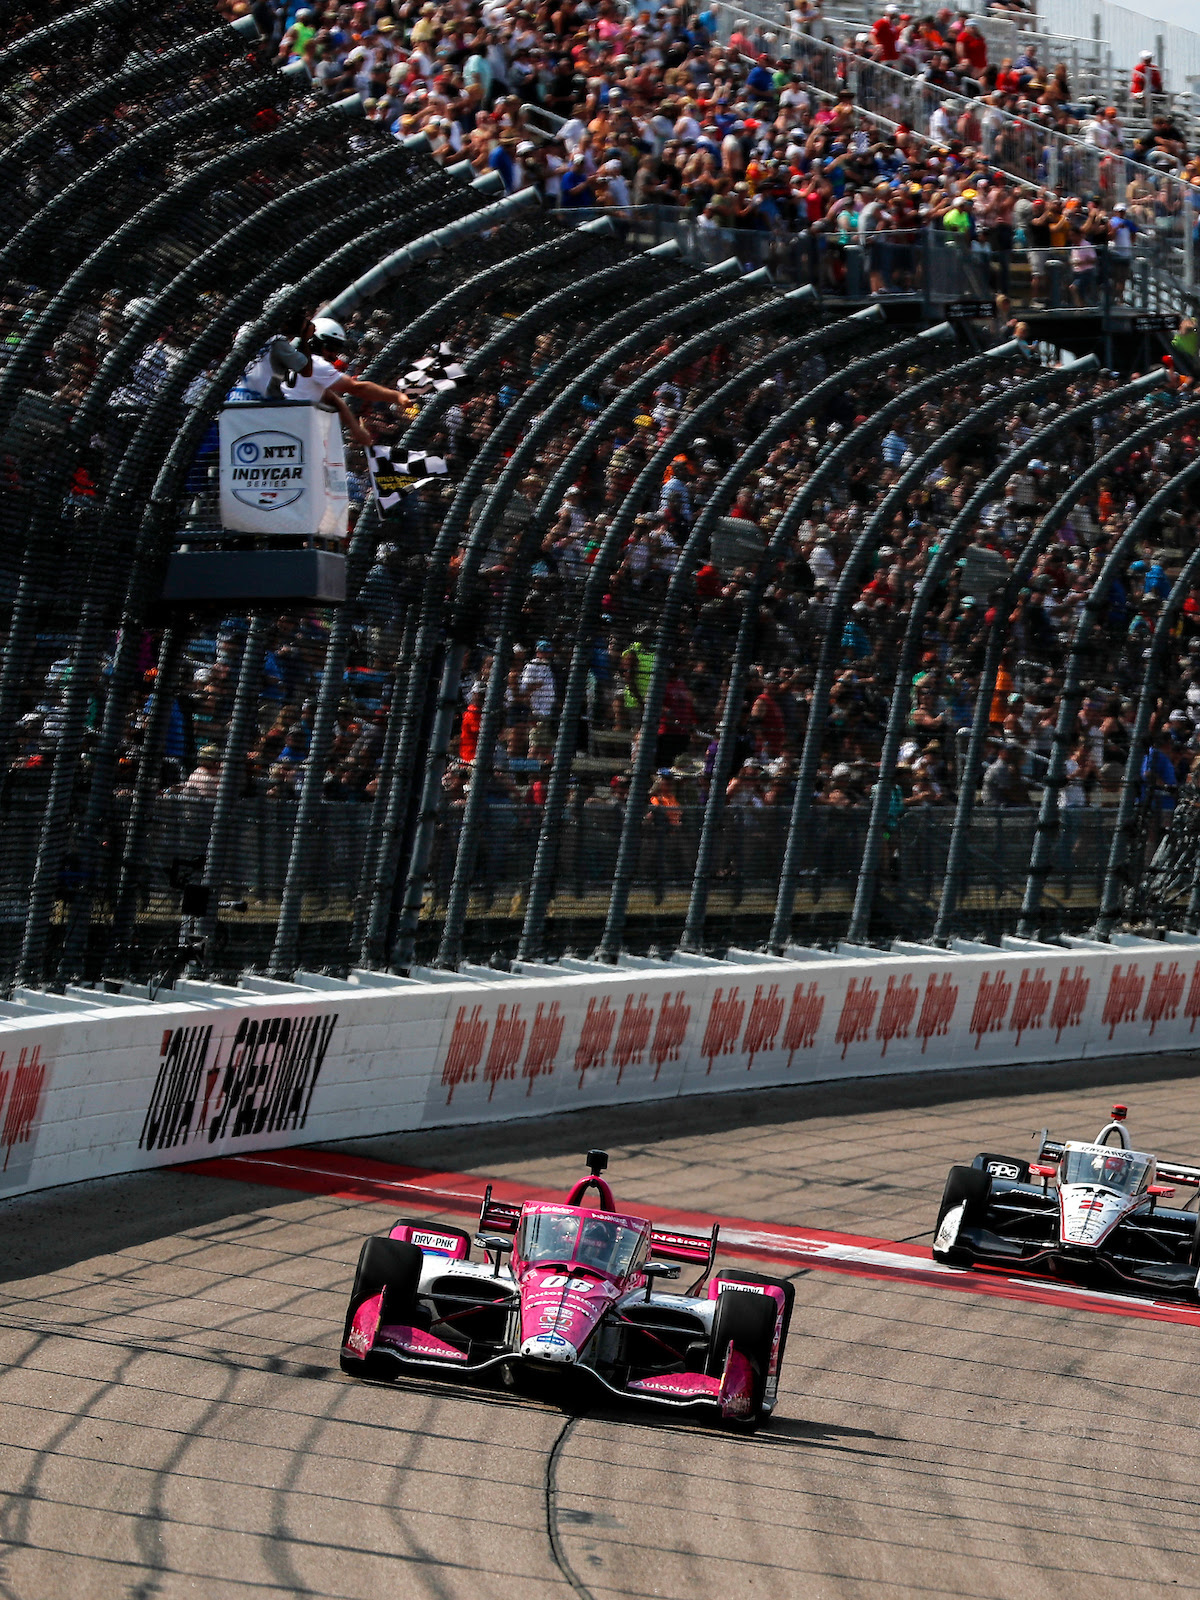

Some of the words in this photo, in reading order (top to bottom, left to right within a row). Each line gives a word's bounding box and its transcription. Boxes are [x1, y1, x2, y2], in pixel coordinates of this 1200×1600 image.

[263, 445, 296, 459] NTT
[232, 468, 303, 481] INDYCAR
[247, 480, 288, 488] SERIES
[208, 1014, 339, 1143] SPEEDWAY
[989, 1165, 1017, 1178] PPG
[1079, 1200, 1104, 1212] 2
[540, 1275, 595, 1293] 06
[385, 1338, 463, 1359] AutoNation
[634, 1381, 715, 1395] AutoNation
